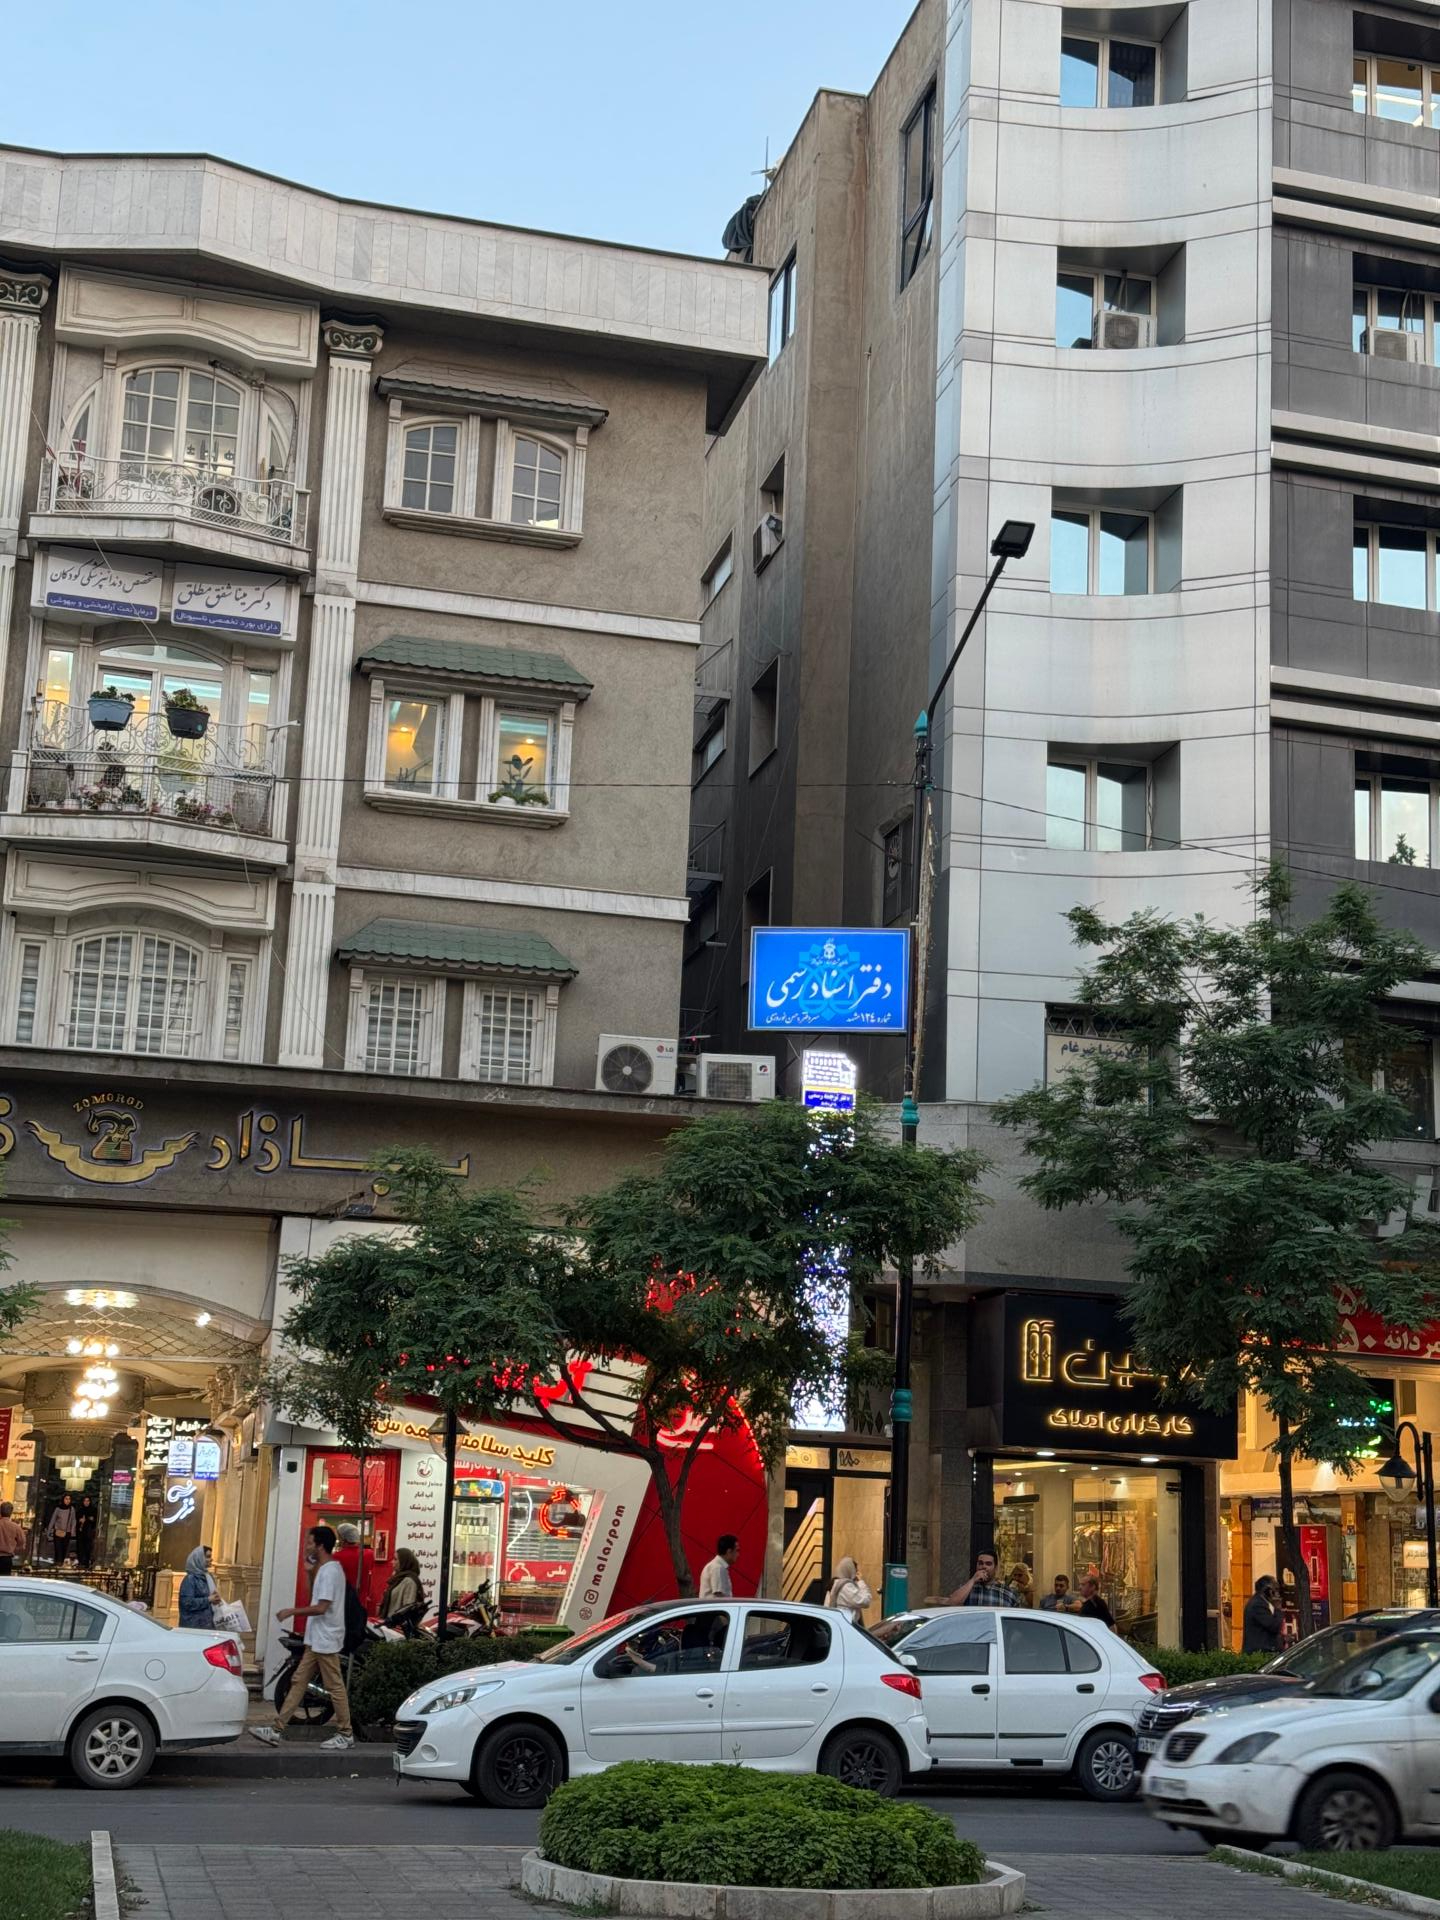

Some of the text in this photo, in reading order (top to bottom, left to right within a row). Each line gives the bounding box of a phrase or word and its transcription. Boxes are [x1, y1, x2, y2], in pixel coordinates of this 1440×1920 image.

[49, 557, 95, 582] کودکان
[122, 571, 158, 594] متخصص
[242, 577, 282, 612] دکتر
[766, 963, 892, 1010] دفتر اسناد رسمی
[73, 1092, 145, 1113] ZOMOROD
[1049, 1407, 1105, 1430] املاک
[512, 1446, 556, 1470] کلید
[592, 1504, 626, 1587] malaspom
